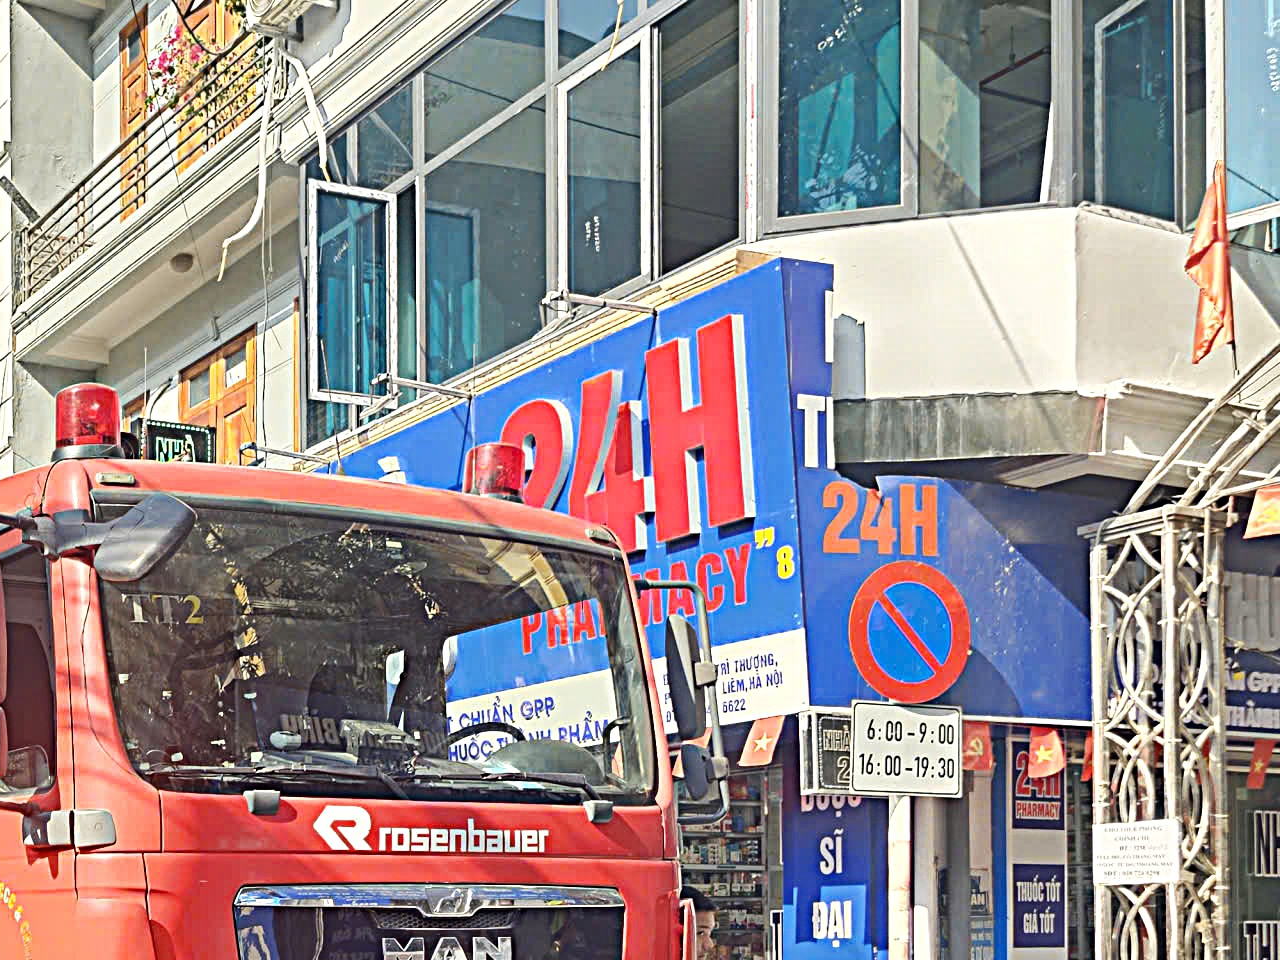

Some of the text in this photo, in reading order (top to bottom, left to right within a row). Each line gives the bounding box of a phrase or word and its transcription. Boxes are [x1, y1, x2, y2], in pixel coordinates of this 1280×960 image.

[822, 480, 938, 556] 24H
[776, 545, 795, 579] 8
[722, 698, 746, 713] 6622
[1016, 801, 1061, 821] PHARMACY
[379, 818, 549, 853] rosenbauer
[820, 829, 844, 875] SĨ
[1017, 875, 1061, 902] THUỐC TỐT
[812, 900, 852, 947] ĐẠI
[1040, 906, 1055, 934] TỐT
